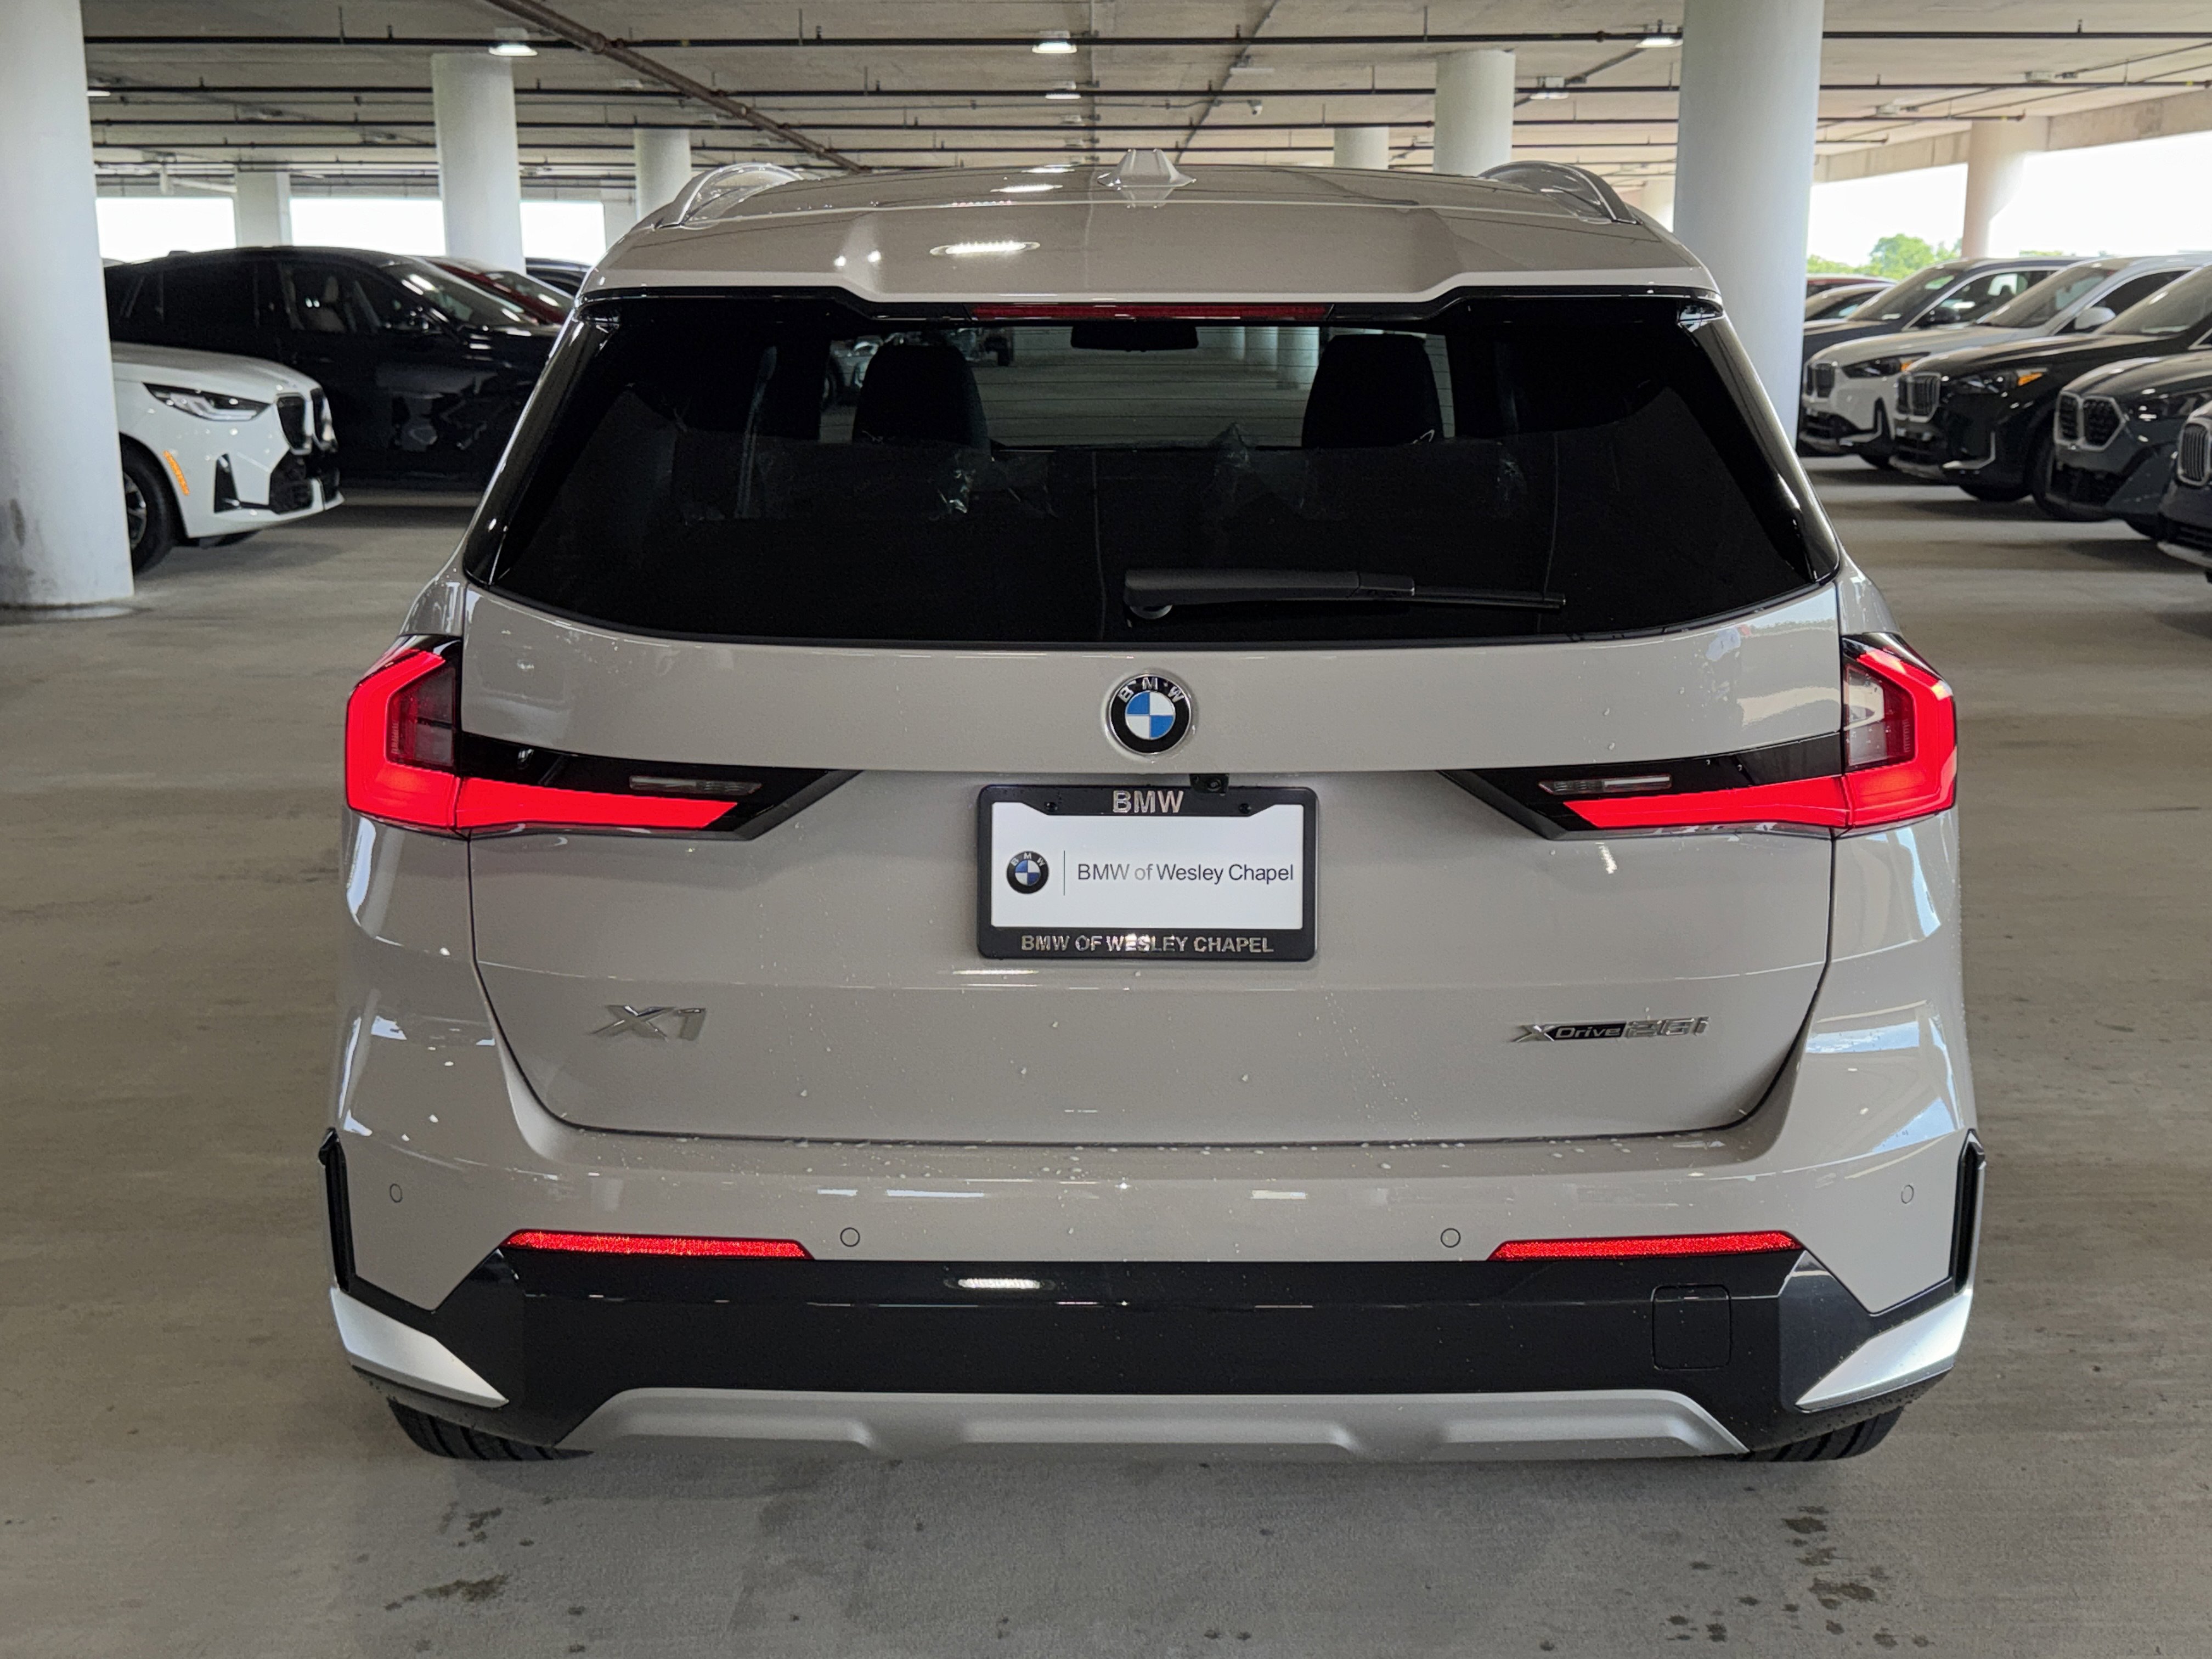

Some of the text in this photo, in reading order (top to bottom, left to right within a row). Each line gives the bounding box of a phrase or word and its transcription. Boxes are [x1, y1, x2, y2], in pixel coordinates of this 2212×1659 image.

[1119, 677, 1185, 703] BMW
[1113, 790, 1183, 813] BMW
[1010, 852, 1045, 866] BMW
[1078, 864, 1294, 884] BMW of Wesley Chapel
[1021, 934, 1274, 953] BMW OF WESLEY CHAPEL
[588, 1005, 707, 1041] X1
